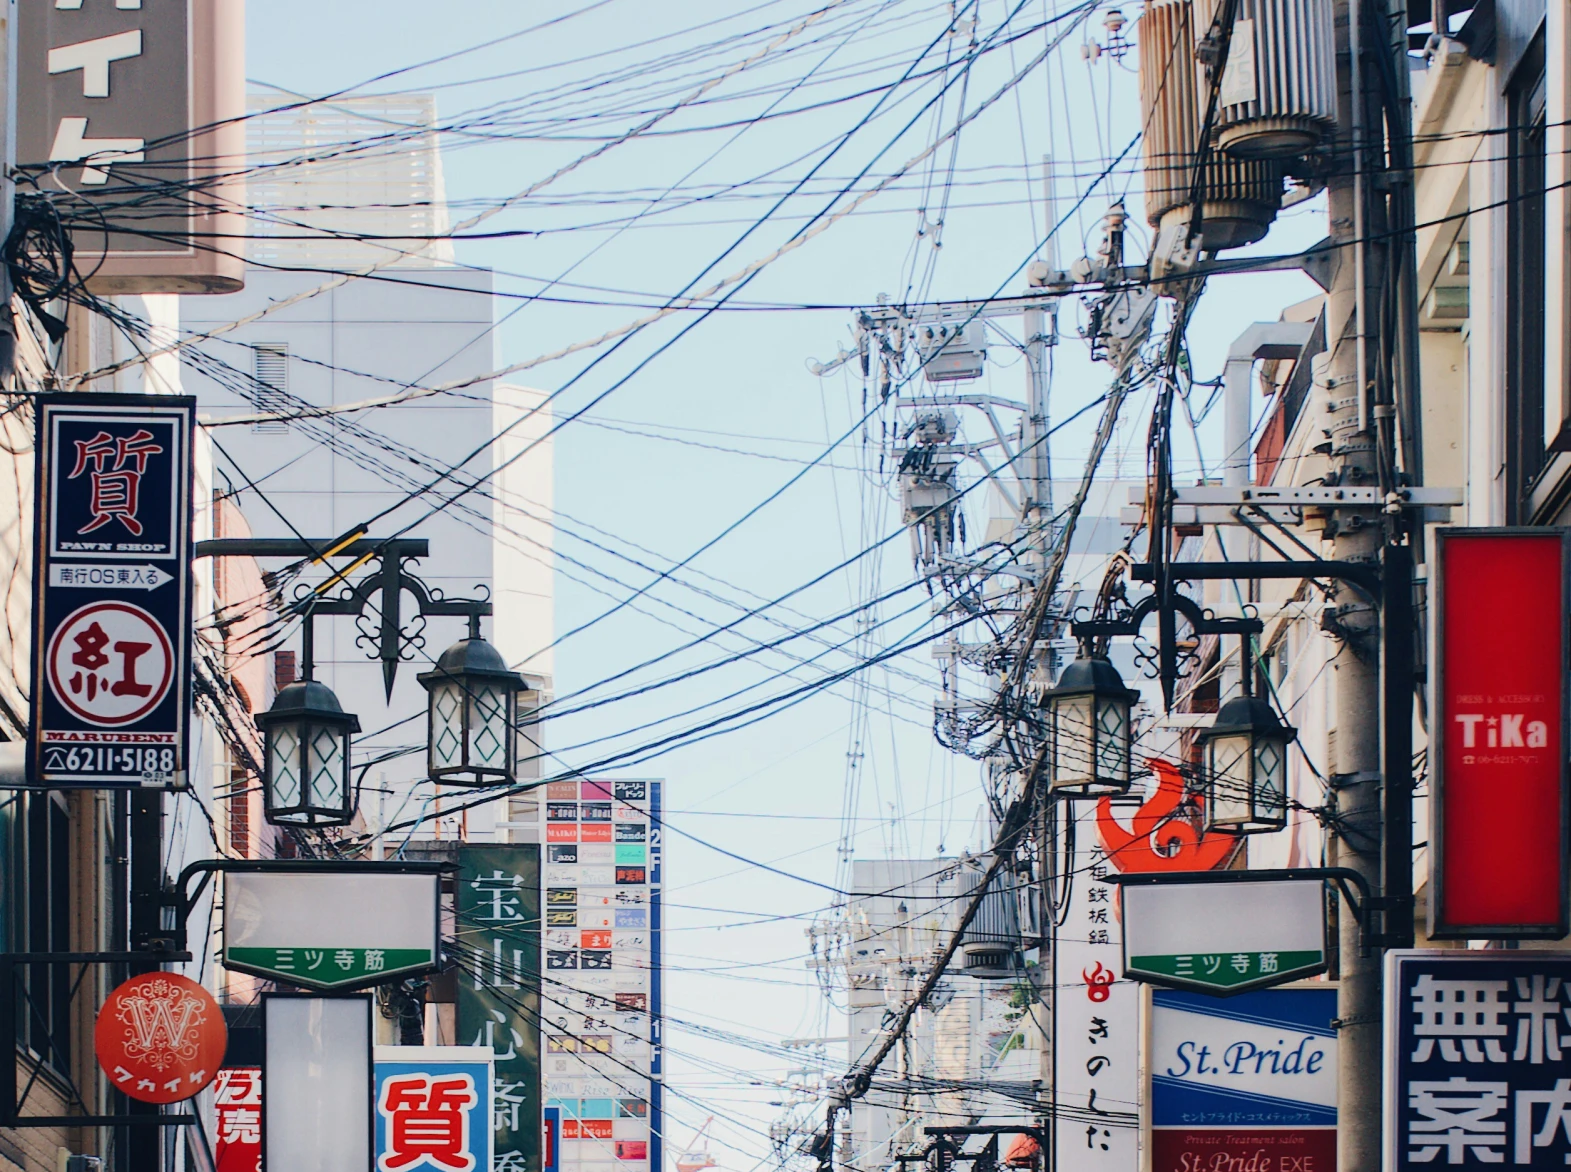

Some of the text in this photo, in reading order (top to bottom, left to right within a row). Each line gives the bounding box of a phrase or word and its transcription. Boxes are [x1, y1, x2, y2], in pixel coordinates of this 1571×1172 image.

[68, 429, 164, 537] 質
[60, 542, 166, 551] PAWN SHOP
[68, 621, 153, 702] 紅
[45, 732, 175, 743] MARUBENI
[1455, 713, 1547, 748] TiKa
[275, 949, 385, 971] 三ツ寺筋
[1175, 953, 1279, 975] 三ツ寺筋
[1086, 1017, 1110, 1151] きのした
[381, 1075, 474, 1172] 質
[1225, 1135, 1275, 1144] Treatment
[1277, 1134, 1305, 1144] salon
[1280, 1156, 1314, 1172] EXE
